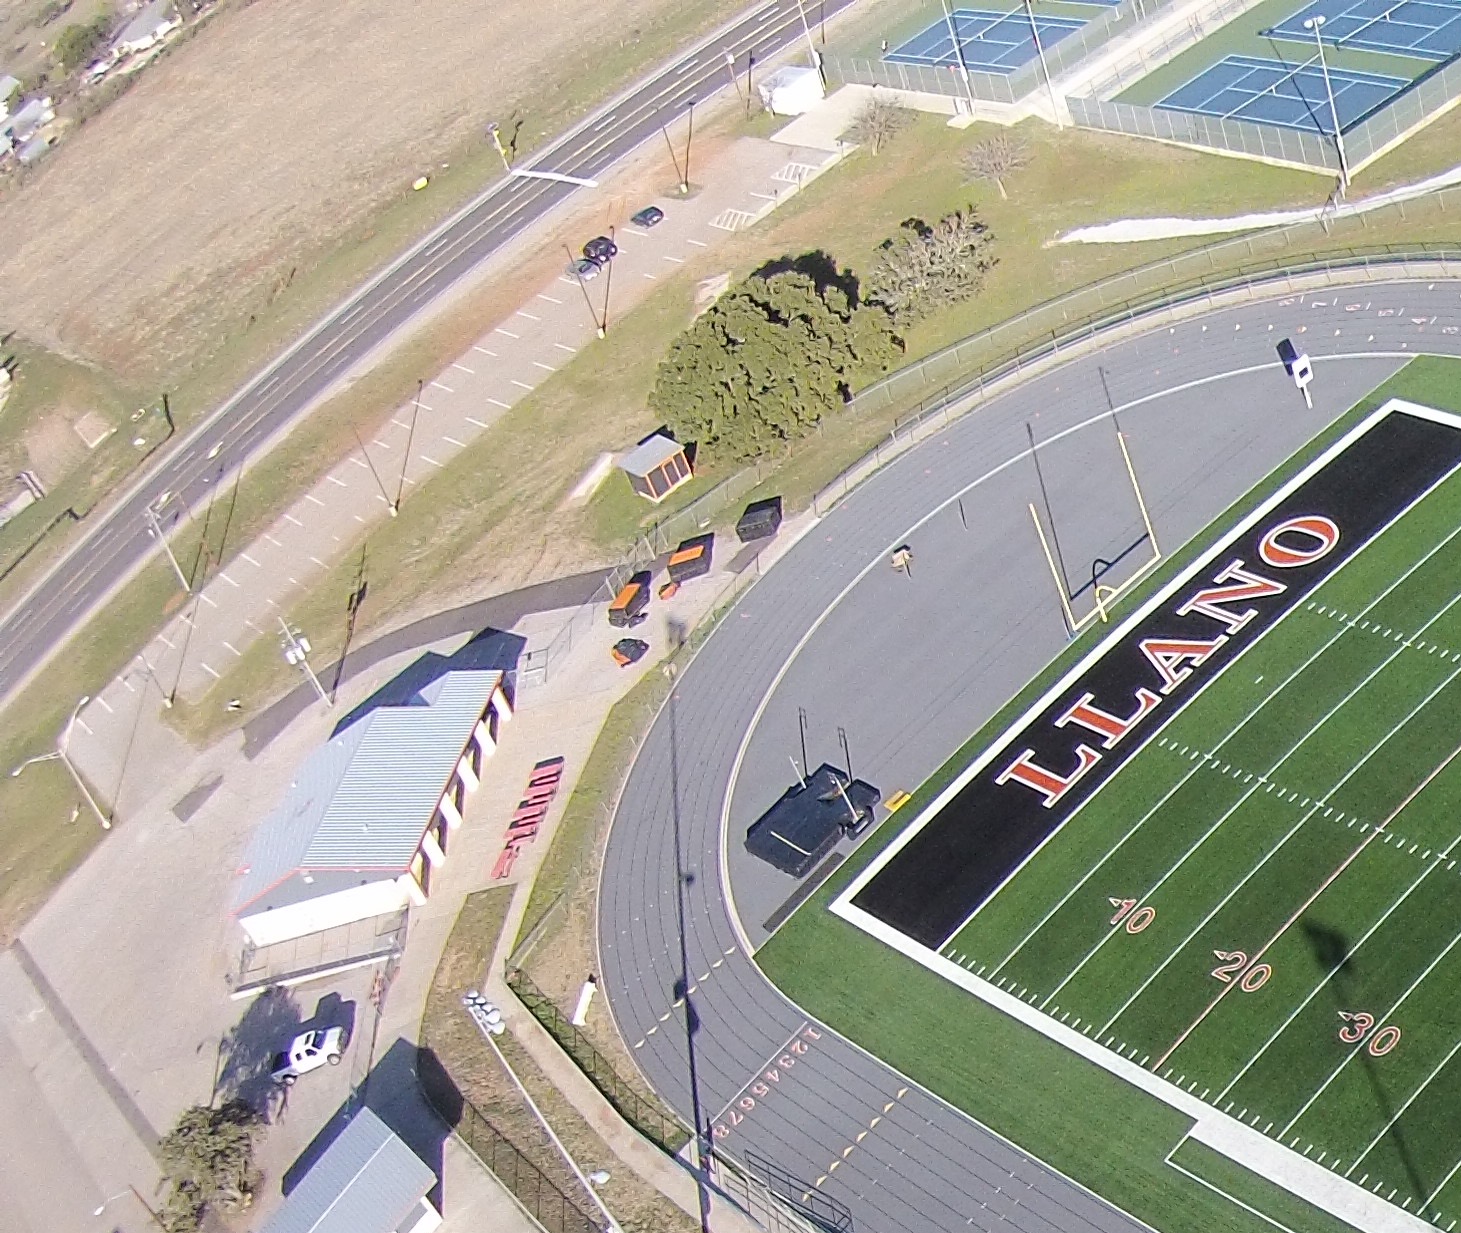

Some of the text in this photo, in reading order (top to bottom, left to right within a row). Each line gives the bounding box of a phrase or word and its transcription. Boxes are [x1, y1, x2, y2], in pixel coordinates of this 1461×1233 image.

[995, 515, 1341, 809] LLANO
[1111, 898, 1156, 934] 10
[1210, 952, 1271, 993] 20
[1338, 1014, 1401, 1057] 30
